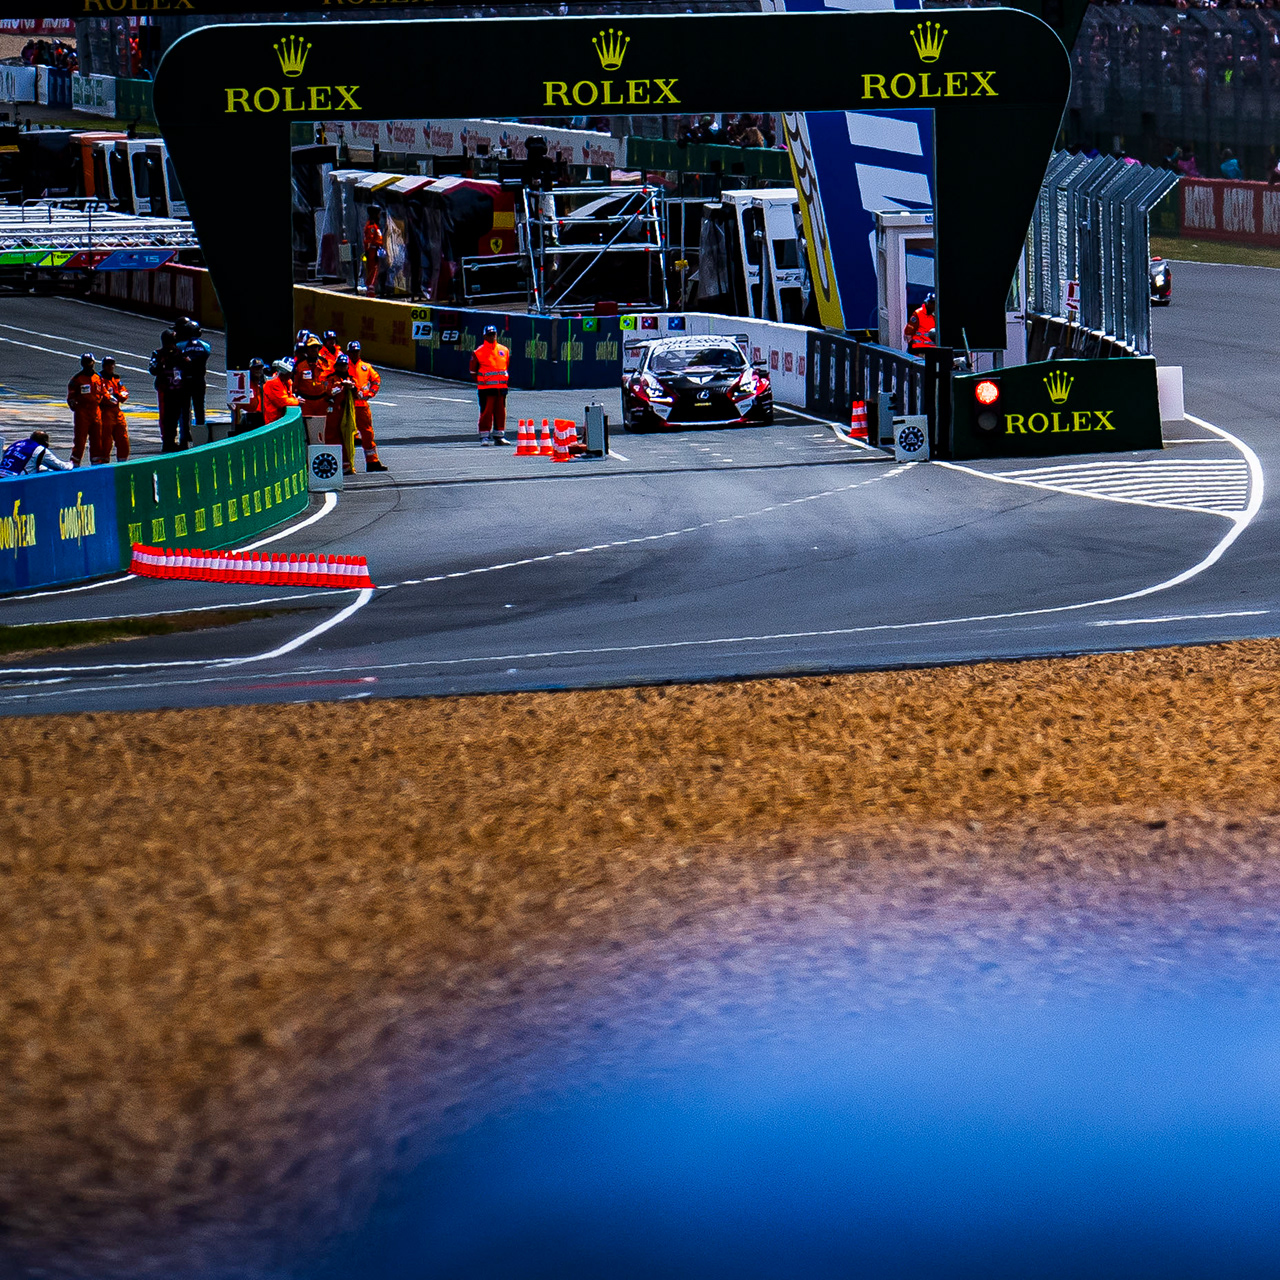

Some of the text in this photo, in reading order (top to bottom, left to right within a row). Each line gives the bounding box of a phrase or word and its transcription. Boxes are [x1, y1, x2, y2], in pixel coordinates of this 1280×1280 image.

[543, 78, 681, 106] ROLEX
[861, 71, 999, 99] ROLEX
[224, 85, 363, 113] ROLEX
[411, 309, 428, 321] 60
[414, 324, 432, 337] 19
[441, 330, 459, 341] 63
[1005, 410, 1116, 434] ROLEX
[0, 513, 37, 551] OODYEAR
